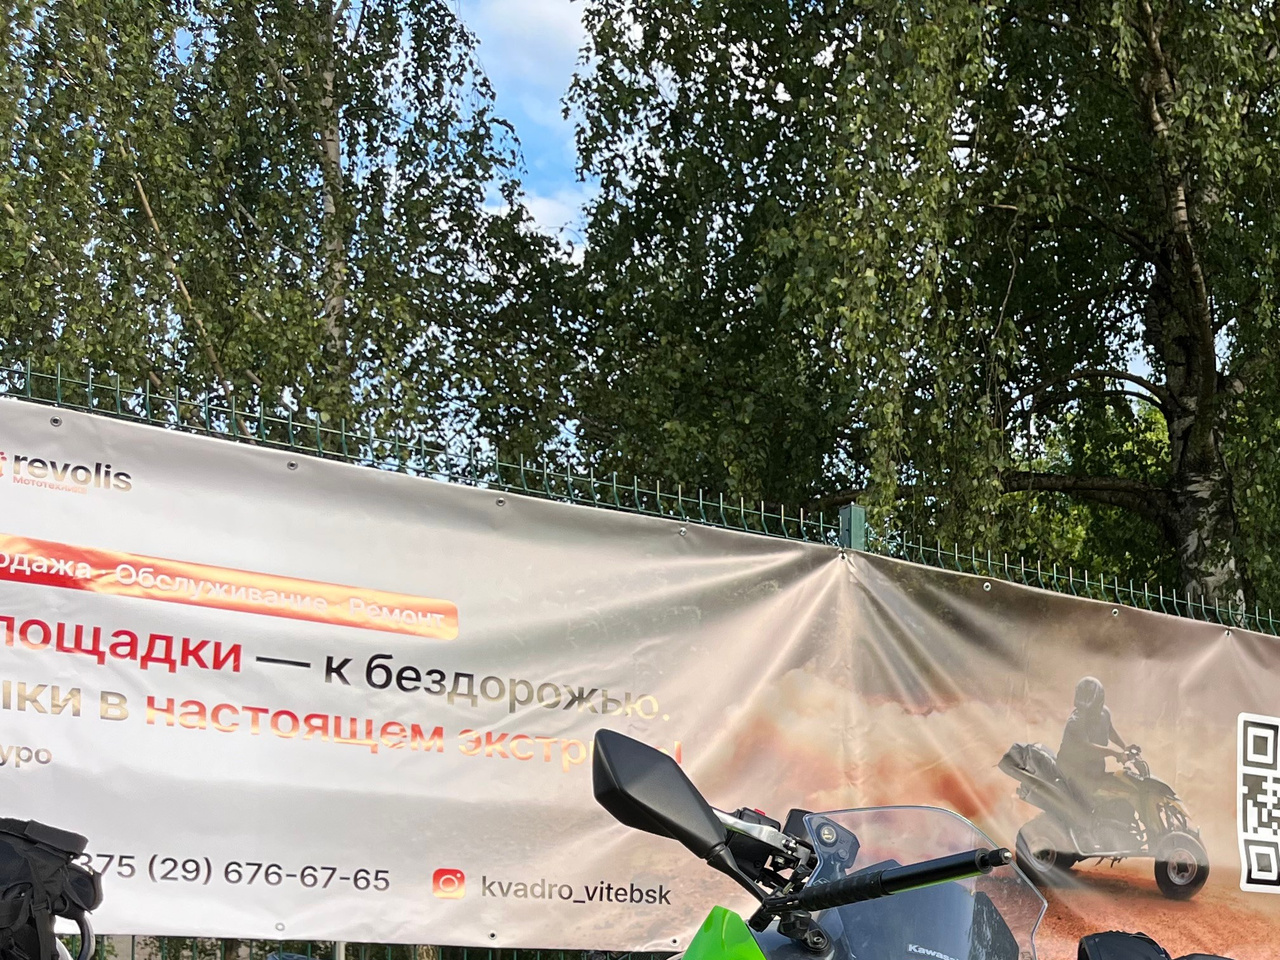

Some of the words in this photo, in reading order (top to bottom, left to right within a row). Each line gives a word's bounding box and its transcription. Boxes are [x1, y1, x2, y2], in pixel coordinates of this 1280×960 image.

[13, 455, 133, 492] revolis
[115, 563, 328, 613] Обслуживание
[349, 597, 446, 629] Ремонт
[325, 655, 353, 686] к
[366, 653, 671, 722] бездорожью.
[2, 680, 82, 717] ки
[100, 690, 130, 722] в
[146, 695, 444, 754] настоящем
[149, 853, 212, 885] (29)
[223, 861, 390, 891] 676-67-65
[481, 875, 672, 905] kvadro_vitebsk
